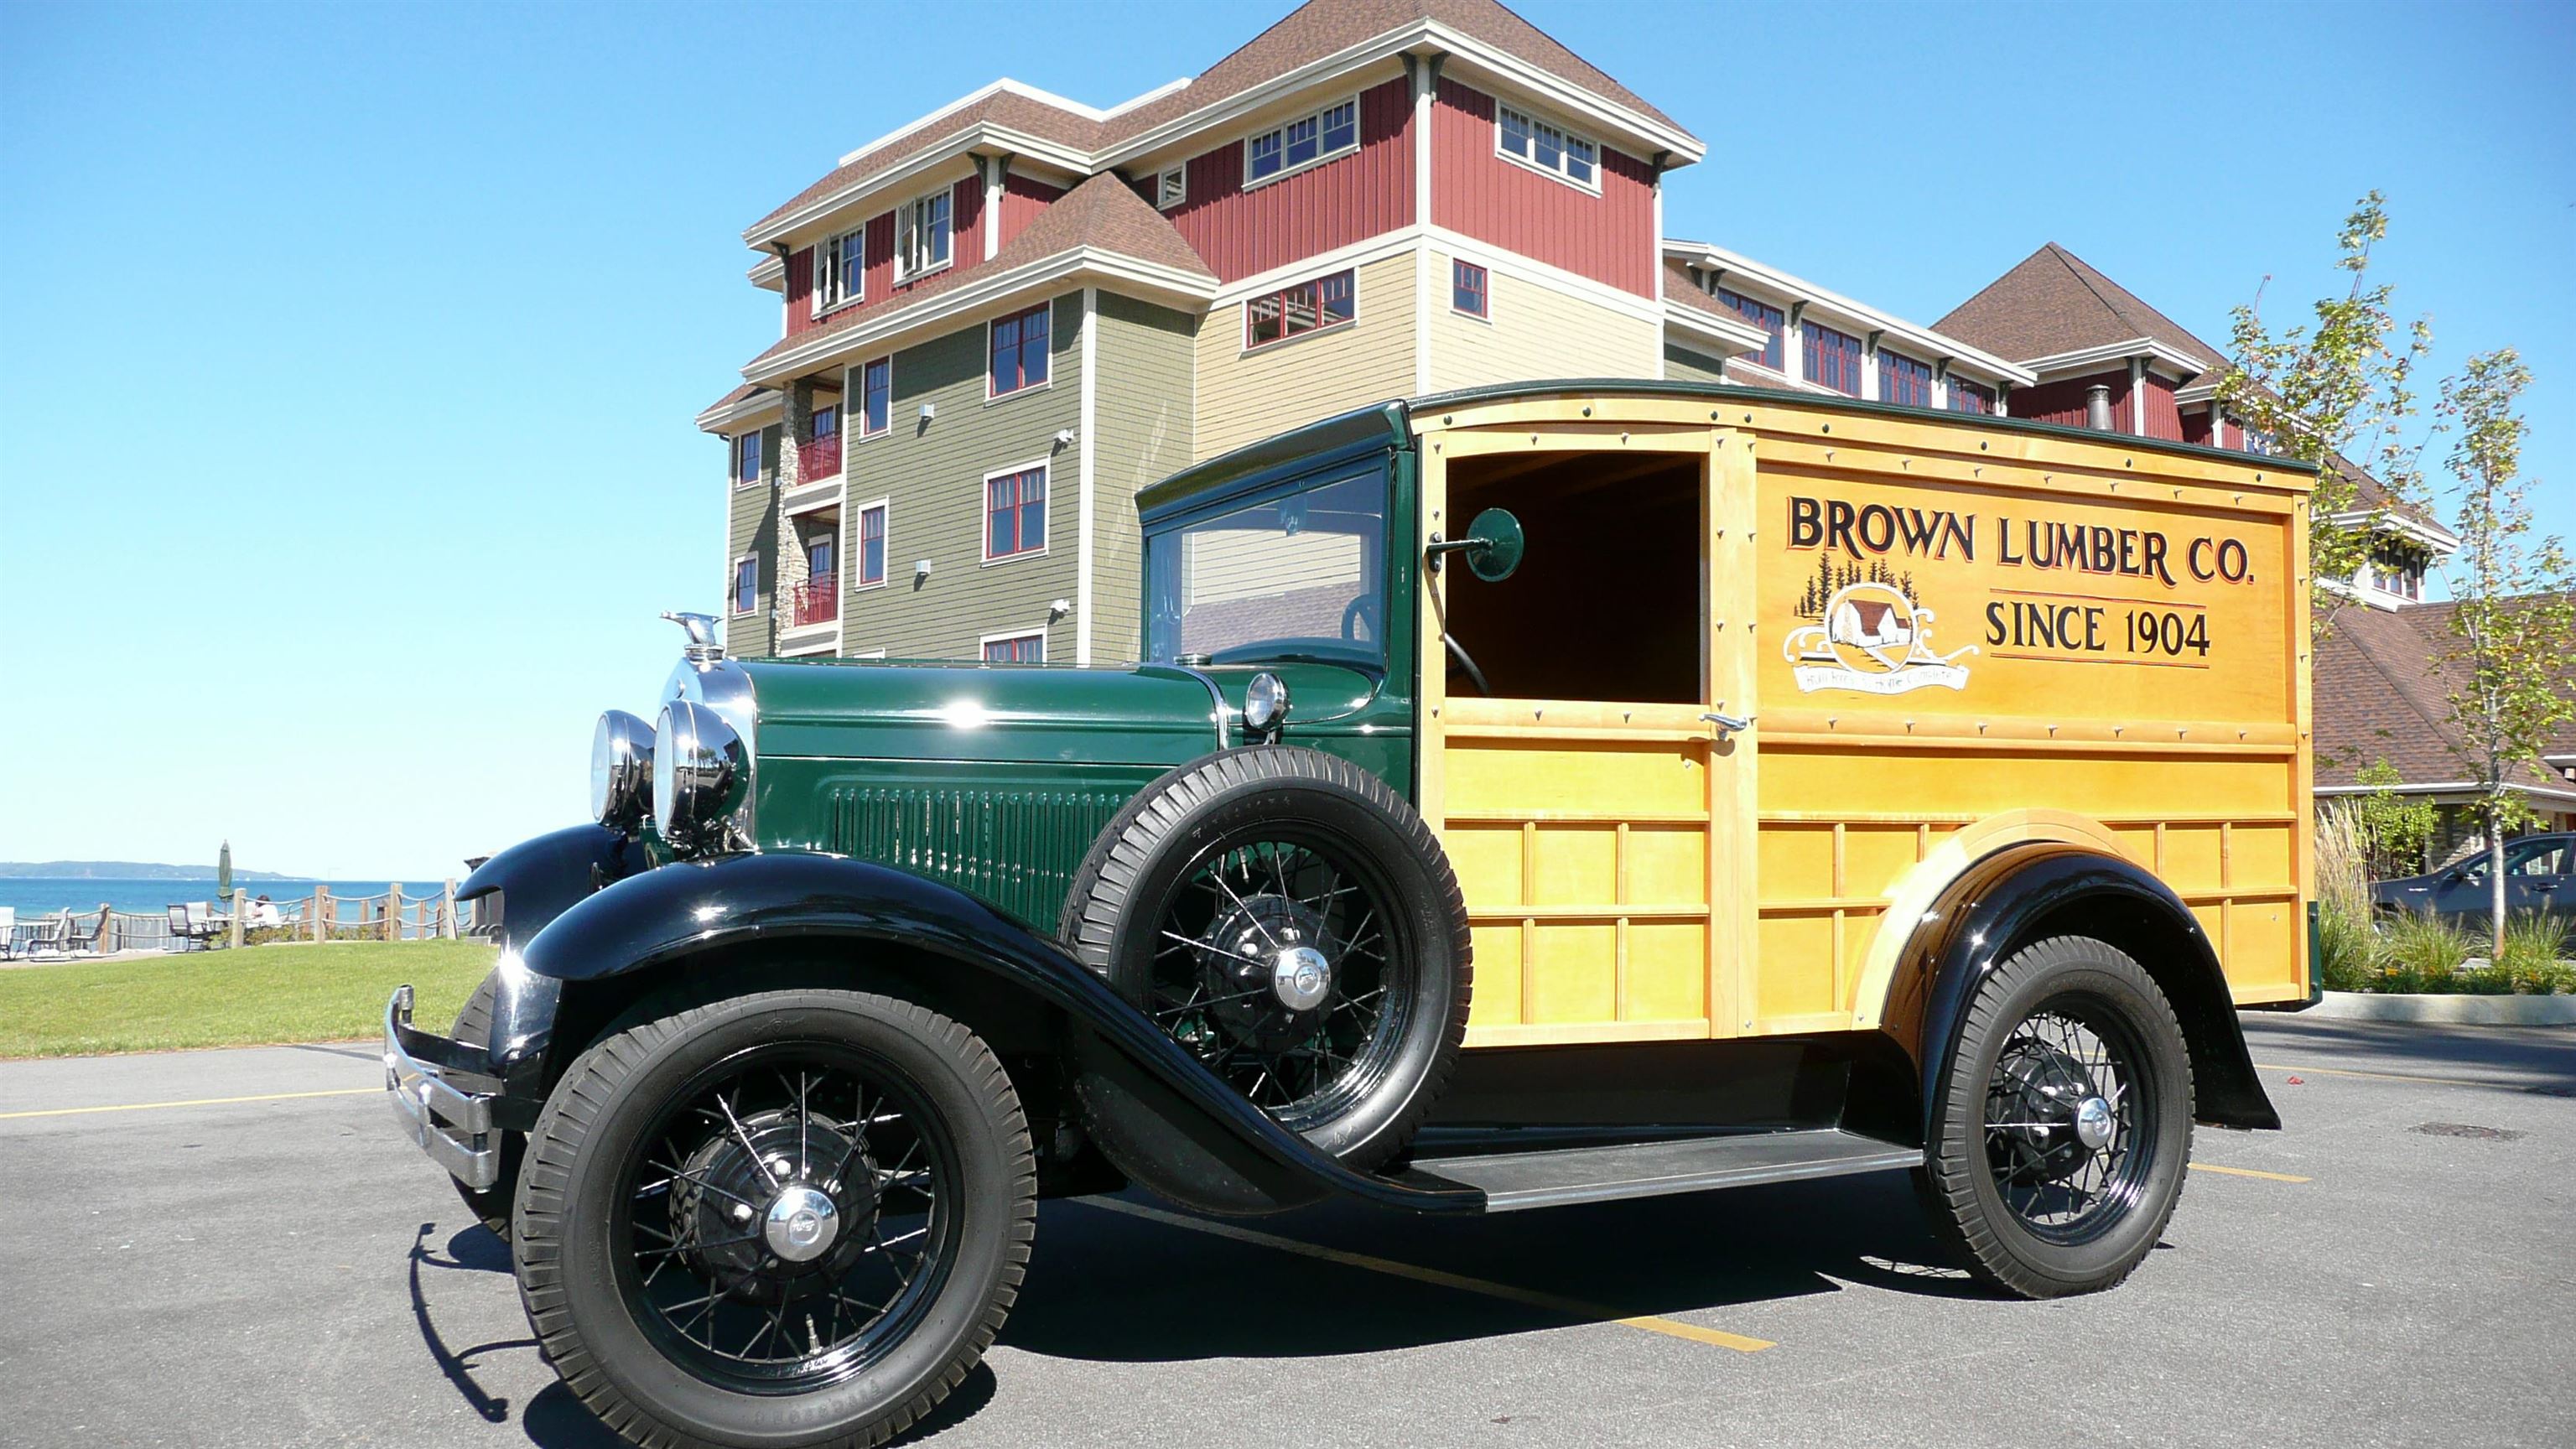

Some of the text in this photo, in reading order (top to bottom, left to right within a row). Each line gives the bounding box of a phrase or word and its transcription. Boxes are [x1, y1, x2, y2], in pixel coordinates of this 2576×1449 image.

[1786, 496, 2256, 588] BROWN LUMBER CO.
[1986, 601, 2211, 657] SINCE 1904
